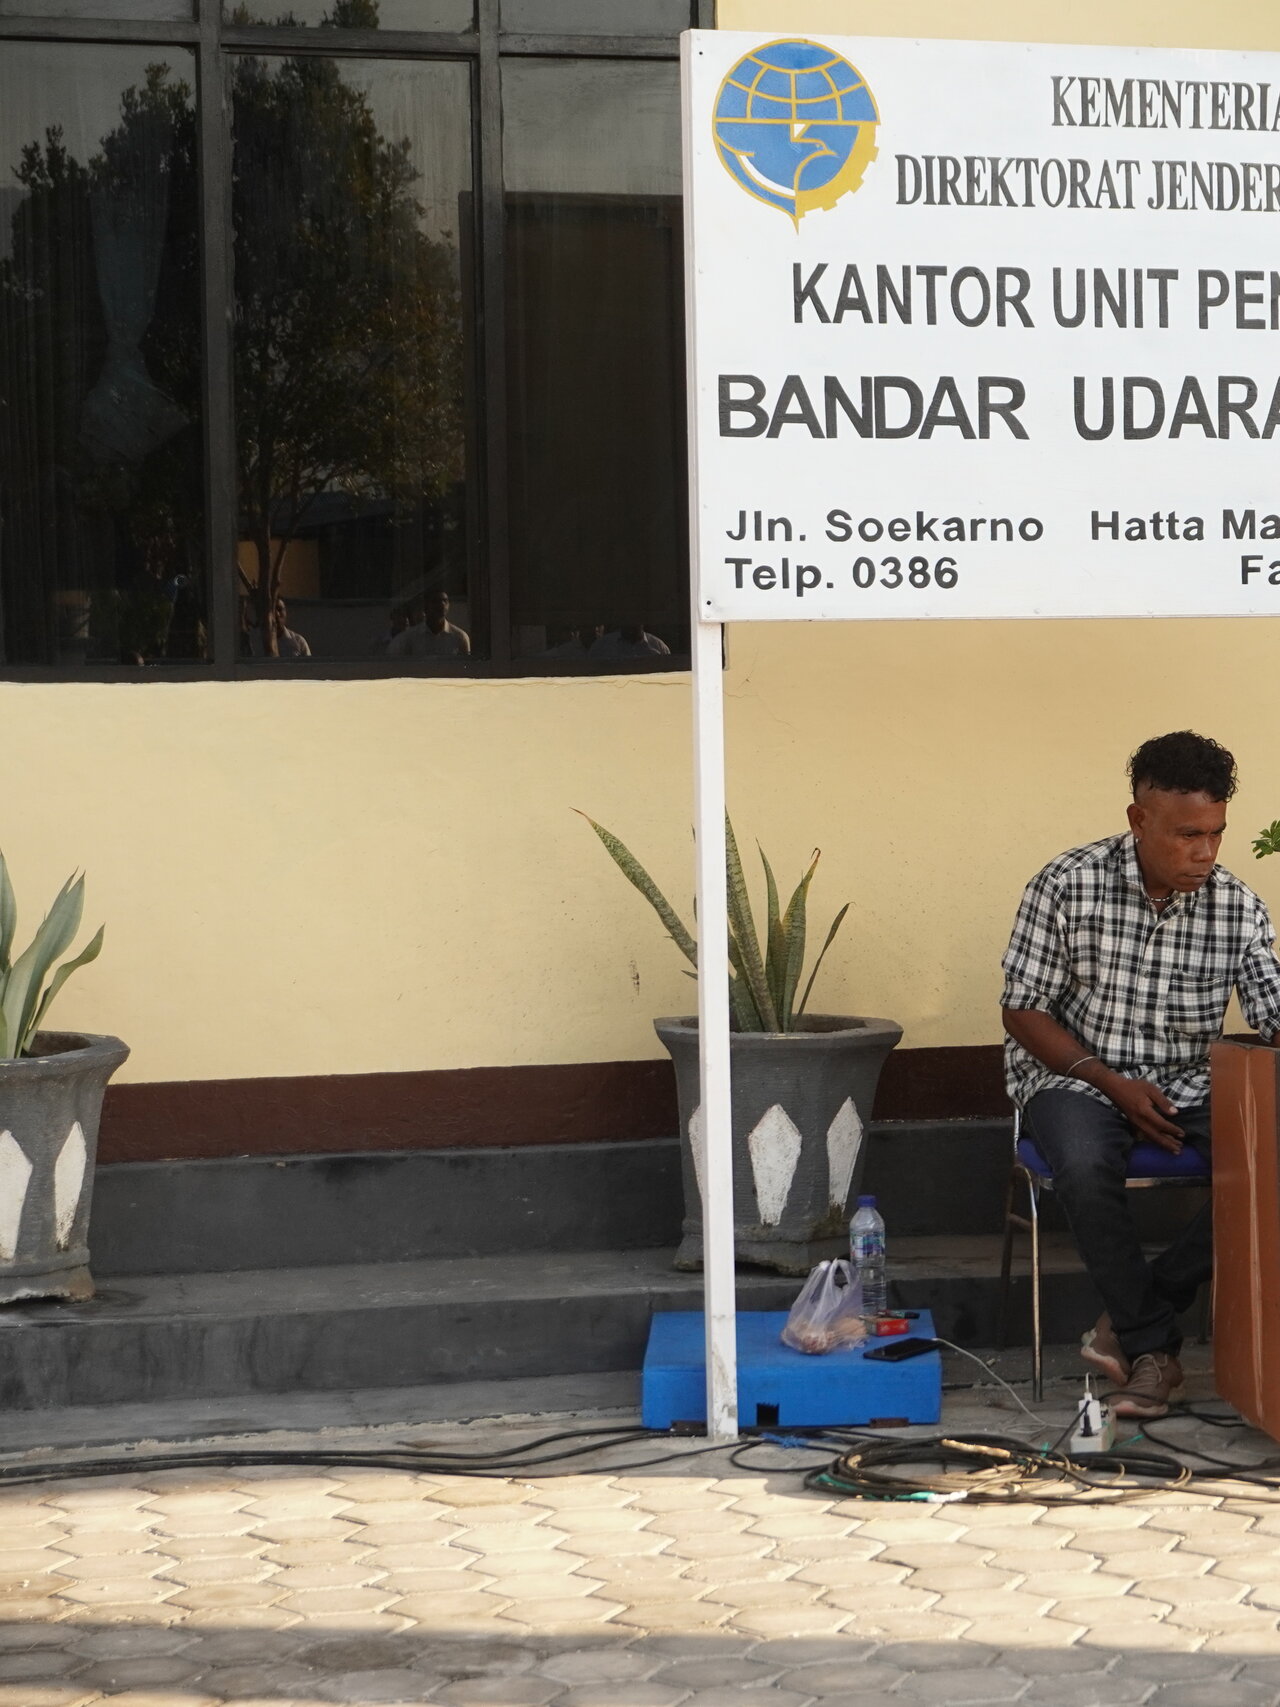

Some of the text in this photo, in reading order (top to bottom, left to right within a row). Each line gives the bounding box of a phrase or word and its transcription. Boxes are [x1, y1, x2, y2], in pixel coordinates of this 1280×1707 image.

[894, 153, 1141, 210] DIREKTORAT
[792, 262, 1036, 329] KANTOR
[1051, 266, 1180, 329] UNIT
[717, 373, 1031, 440] BANDAR
[724, 509, 807, 543] Jln.
[824, 508, 1045, 543] Soekarno
[1090, 509, 1205, 542] Hatta
[723, 554, 960, 599] Telp. 0386
